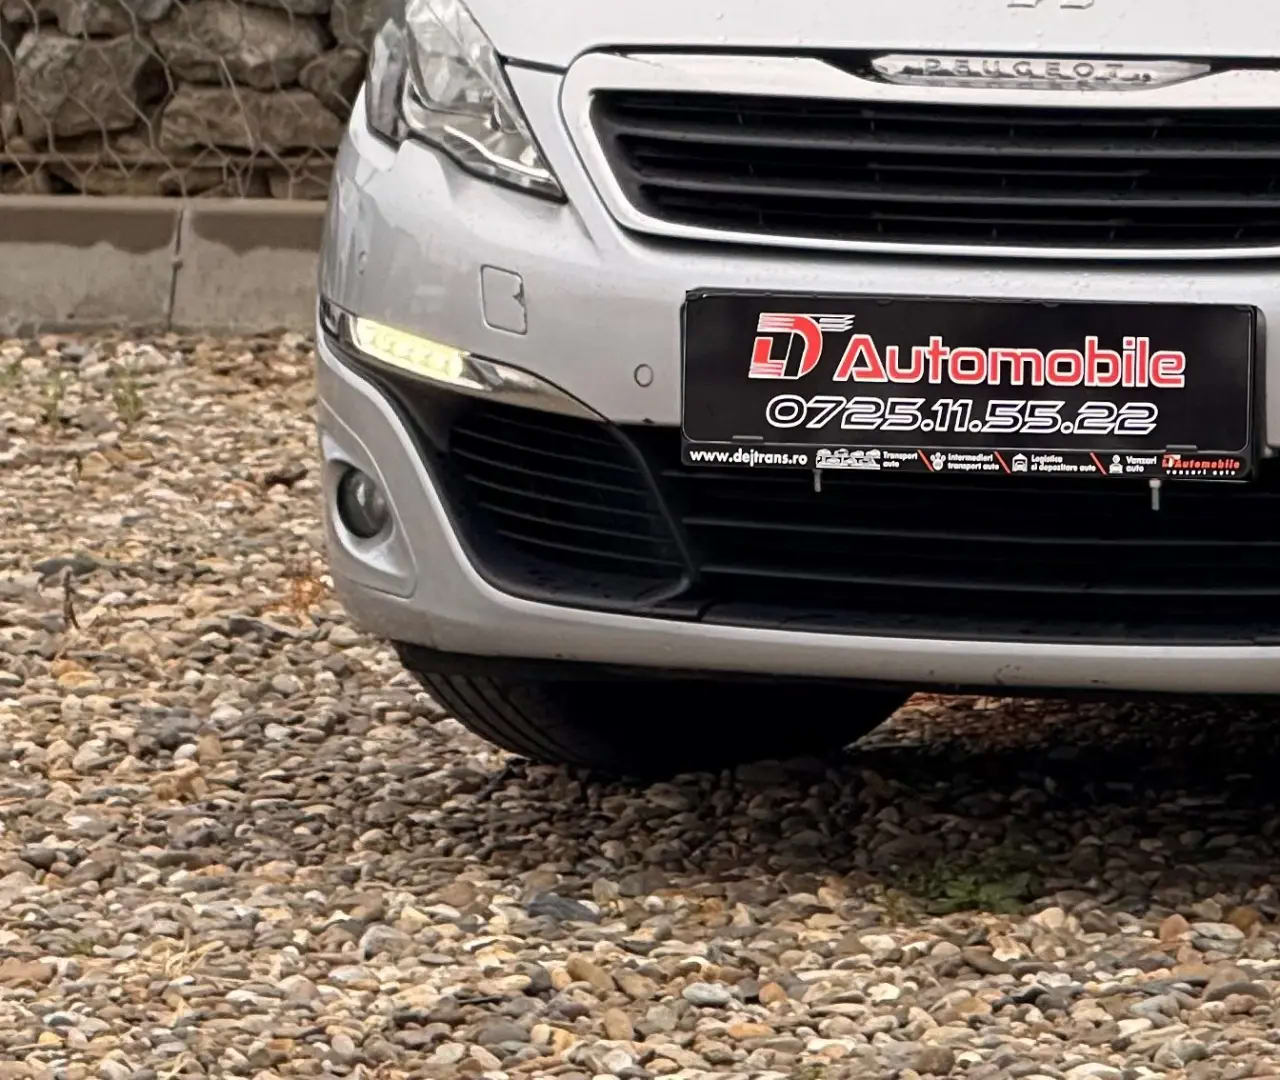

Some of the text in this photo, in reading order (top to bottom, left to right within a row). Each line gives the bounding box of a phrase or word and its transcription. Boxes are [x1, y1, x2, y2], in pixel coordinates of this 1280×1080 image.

[924, 58, 1124, 79] PEUGEOT
[832, 333, 1186, 389] Automobile
[766, 393, 1159, 436] 0725.11.55.22
[689, 448, 808, 468] www.dejtrans.ro
[883, 450, 918, 461] Transport
[883, 460, 900, 468] auto
[947, 462, 1000, 471] transport auto
[1079, 464, 1097, 472] auto
[1125, 464, 1145, 473] auto
[1174, 458, 1240, 469] Automobile
